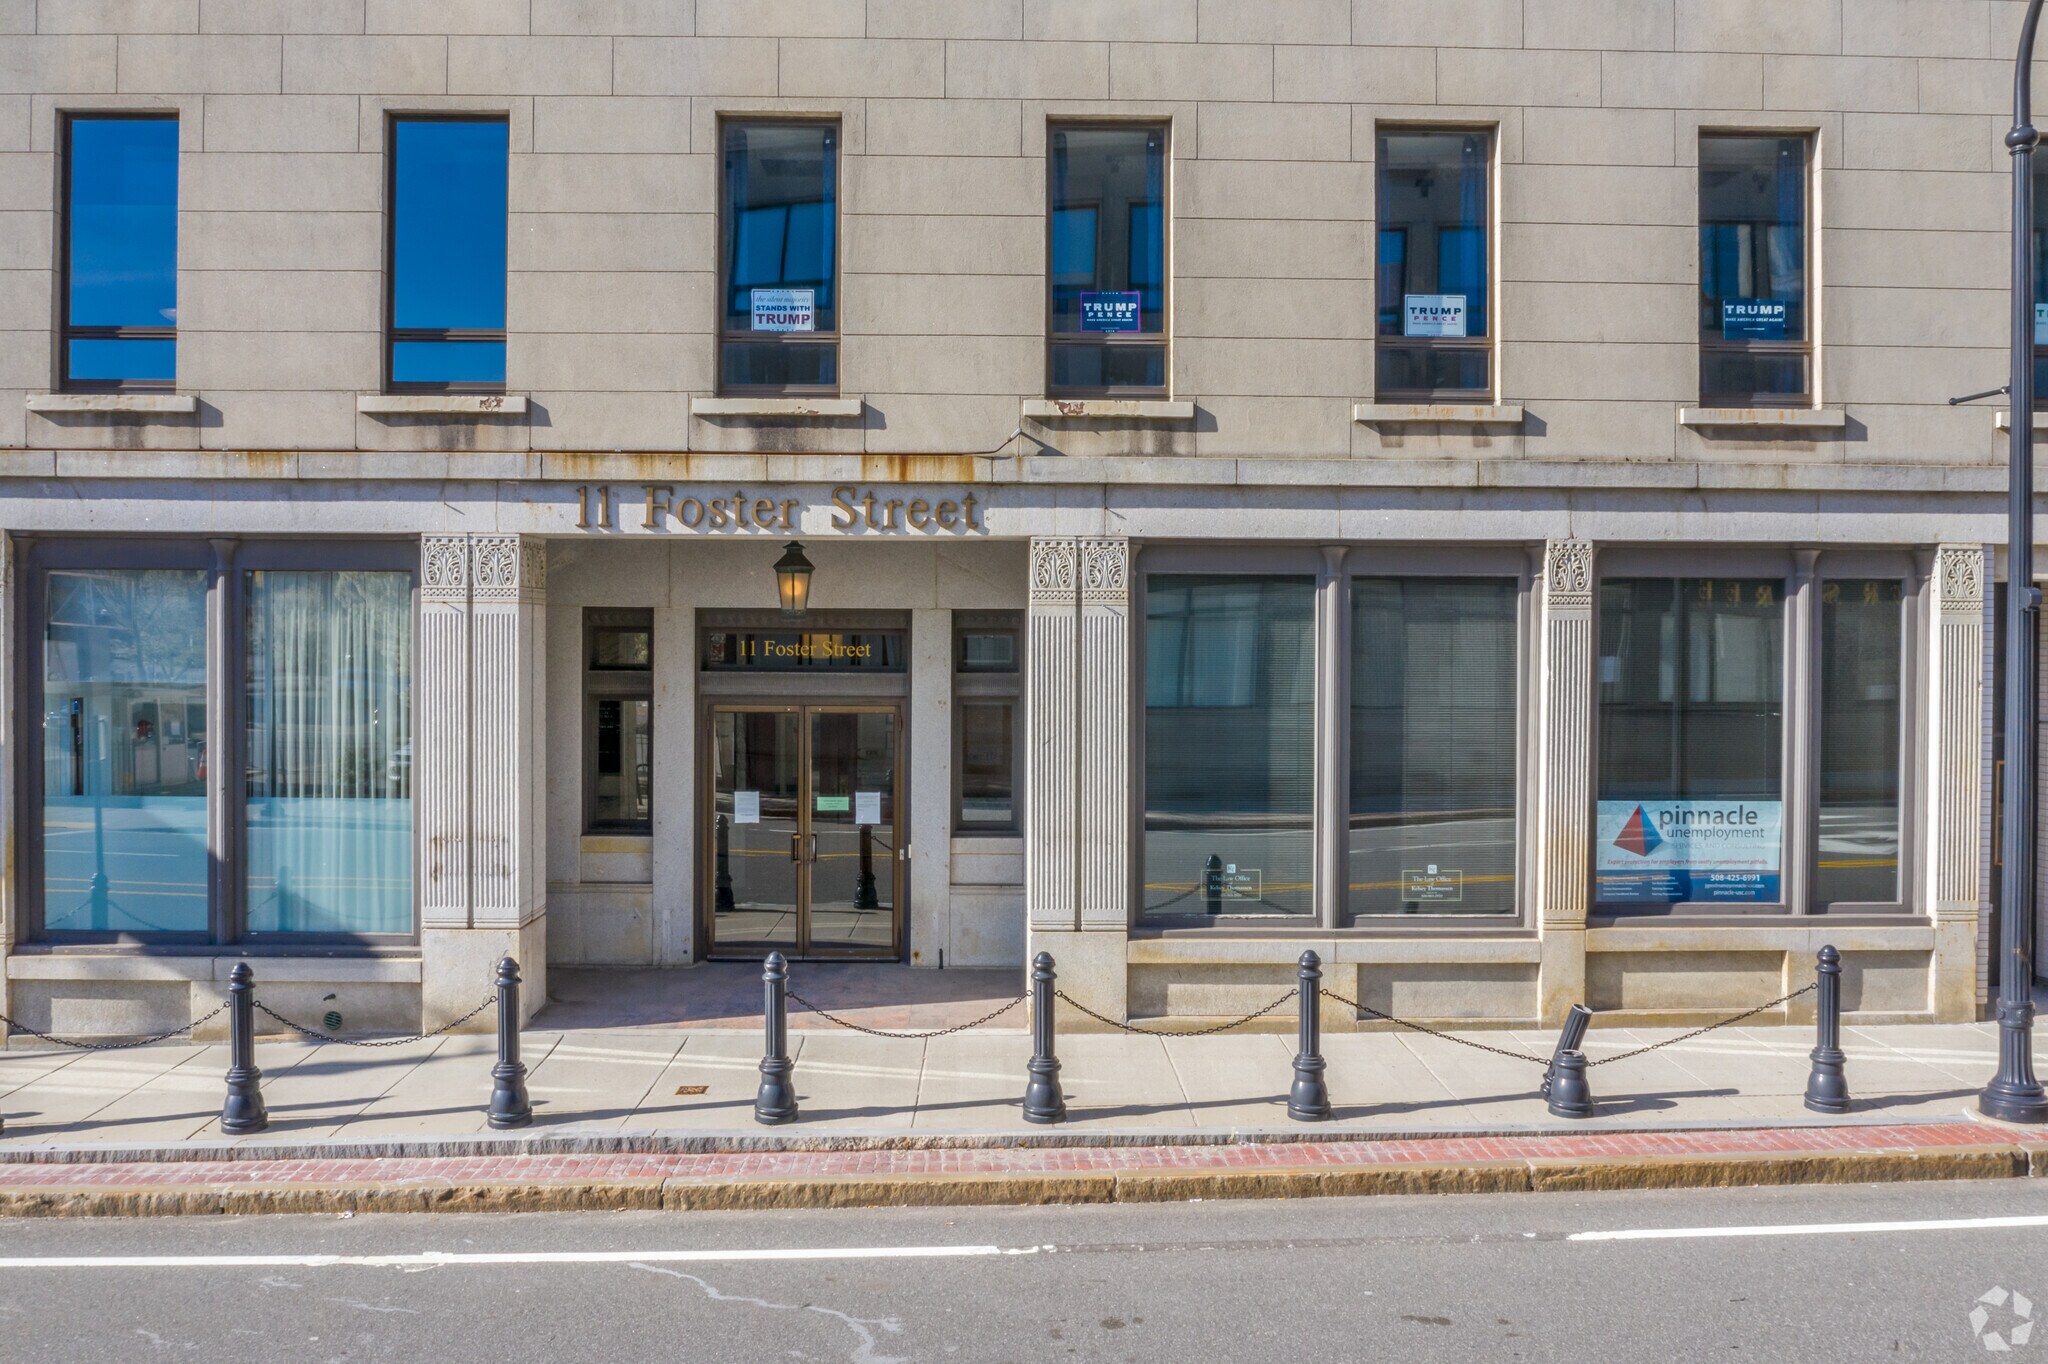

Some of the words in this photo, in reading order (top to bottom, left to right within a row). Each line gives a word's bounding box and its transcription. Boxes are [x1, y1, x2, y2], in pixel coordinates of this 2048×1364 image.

[1083, 303, 1137, 311] TRUMP
[1409, 307, 1462, 315] TRUMP
[1725, 305, 1784, 315] TRUMP
[755, 313, 811, 325] TRUMP
[2036, 309, 2048, 318] T
[575, 485, 613, 528] 11
[641, 484, 800, 529] Foster
[831, 485, 979, 531] Street
[740, 640, 756, 657] 11
[764, 640, 817, 657] Foster
[822, 640, 872, 657] Street
[1659, 804, 1758, 830] pinnacle
[1666, 826, 1765, 840] unemployment
